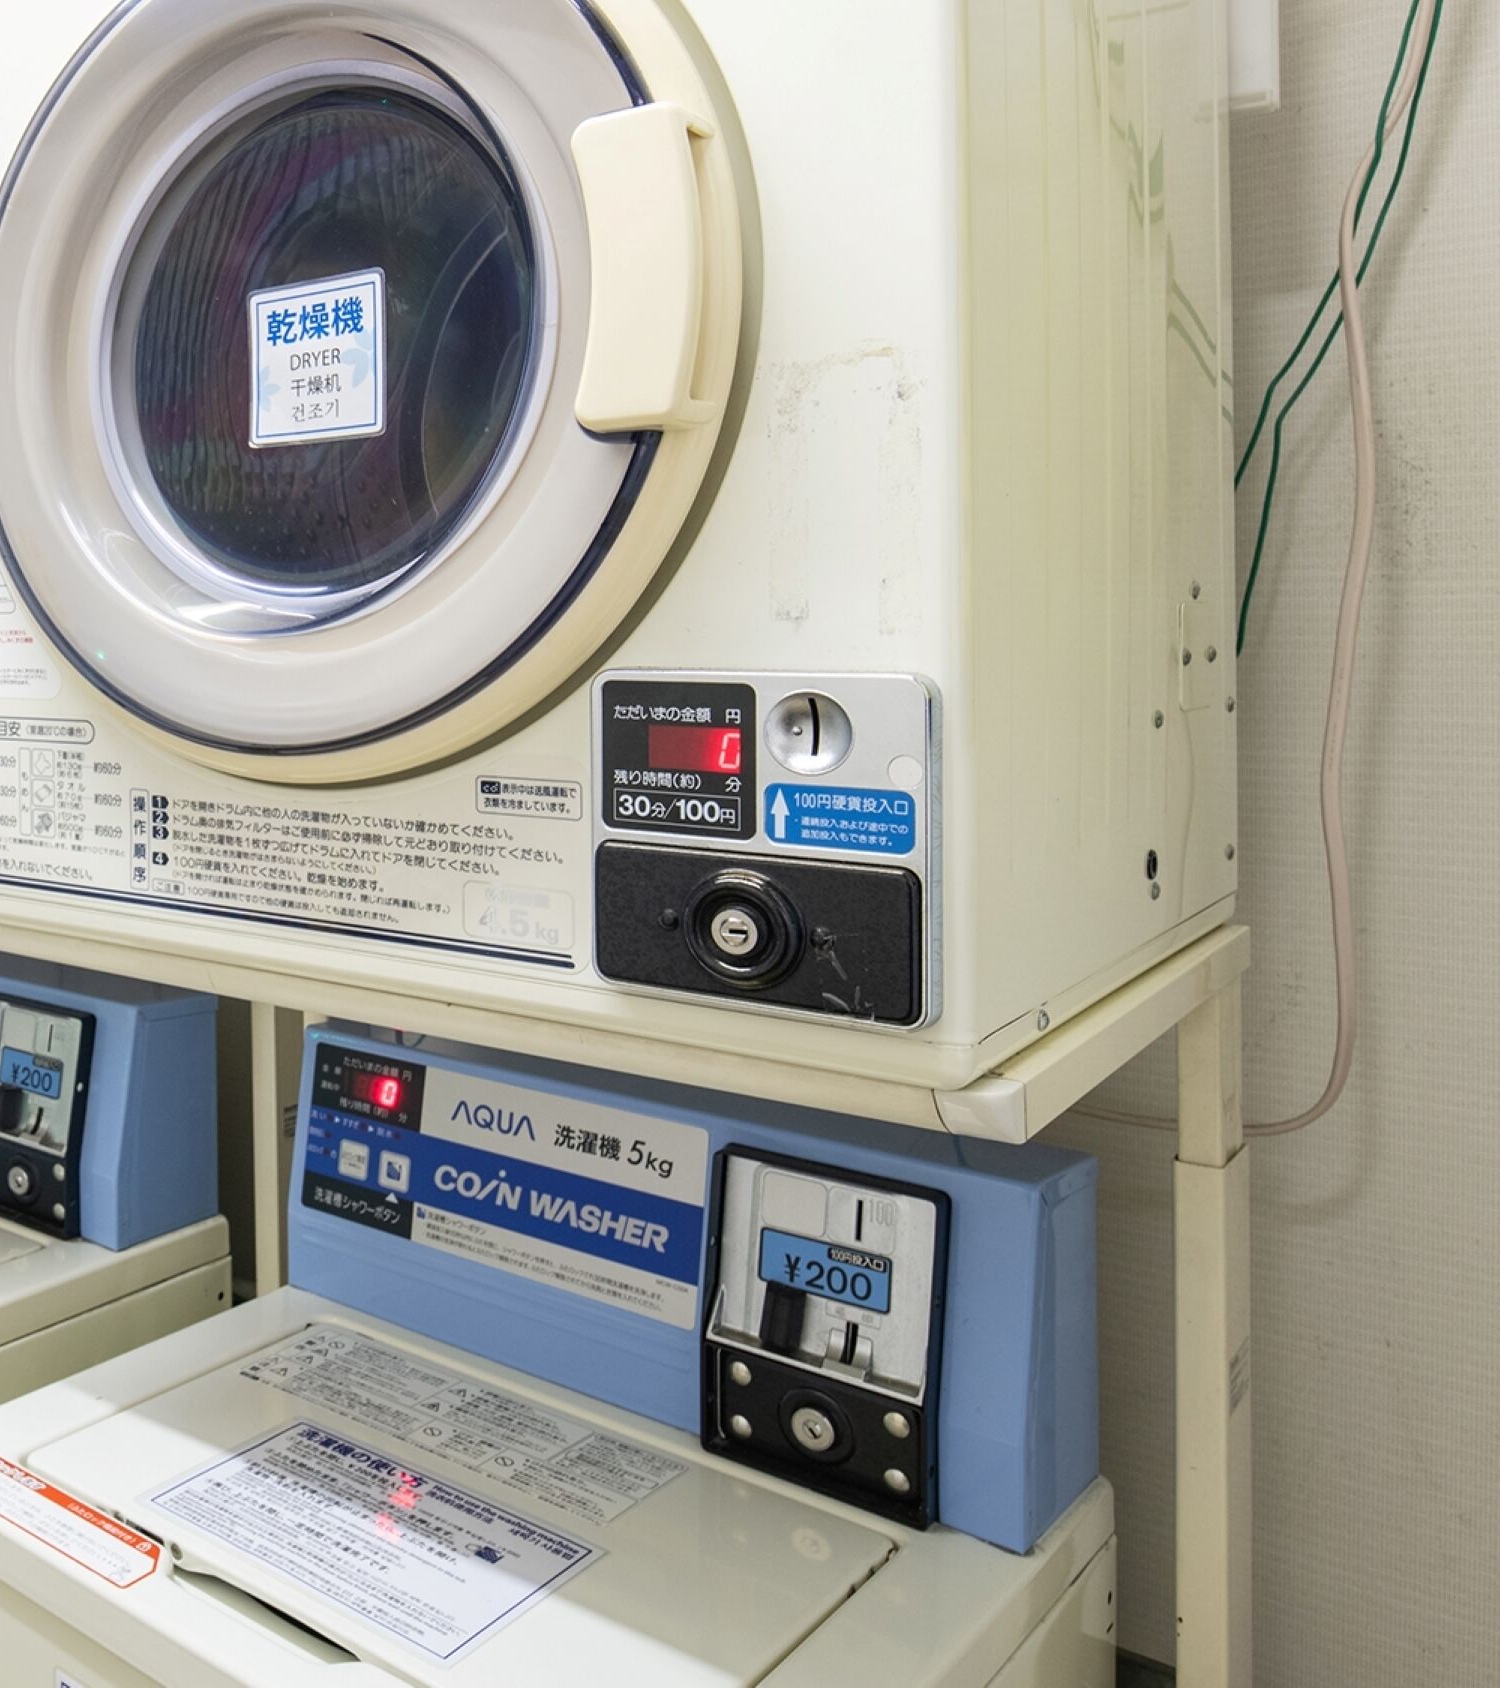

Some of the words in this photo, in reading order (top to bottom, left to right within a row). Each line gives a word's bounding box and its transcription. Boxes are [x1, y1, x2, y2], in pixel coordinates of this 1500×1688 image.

[267, 296, 363, 346] 乾燥機
[290, 347, 341, 371] DRYER
[291, 373, 342, 397] 干燥机
[292, 398, 340, 423] 건조기
[613, 704, 712, 723] ただいまの金額
[725, 708, 741, 724] 円
[718, 732, 741, 770] 0
[613, 768, 702, 790] 残り時間(約)
[725, 776, 742, 793] 分
[618, 794, 737, 825] 30分/100円
[794, 792, 909, 816] 100円硬貨投入口
[132, 795, 147, 884] 操作順序
[478, 903, 531, 936] 4.5
[11, 1061, 53, 1093] ¥200
[380, 1078, 399, 1108] 0
[451, 1100, 536, 1141] AQUA
[554, 1123, 622, 1162] 洗濯機
[529, 1189, 671, 1254] WASHER
[785, 1252, 872, 1301] ¥200
[297, 1427, 429, 1489] 洗濯機の使い方
